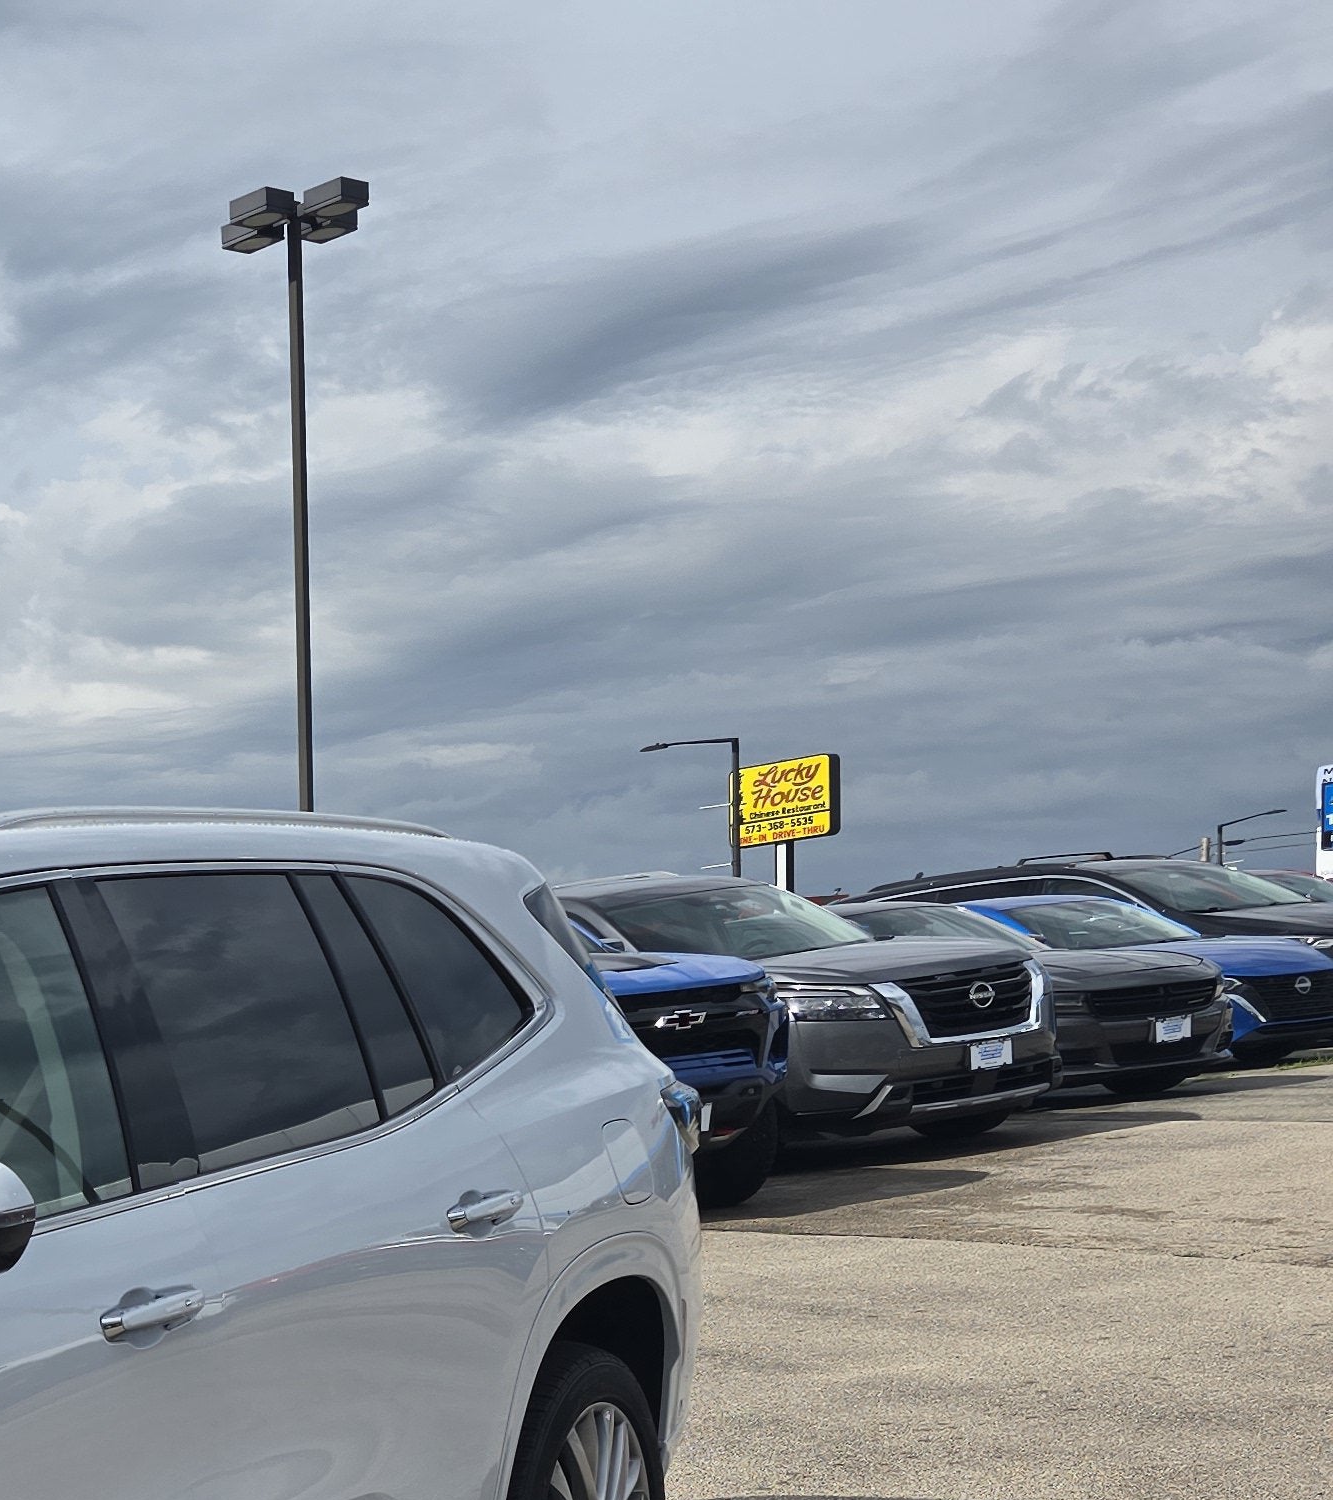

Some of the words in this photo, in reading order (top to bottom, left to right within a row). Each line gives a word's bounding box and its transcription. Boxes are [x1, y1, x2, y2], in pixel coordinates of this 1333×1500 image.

[753, 763, 821, 788] Lucky
[751, 784, 824, 809] House
[749, 809, 780, 820] Chinese
[781, 801, 826, 815] Restaurant
[773, 825, 825, 840] DRIVE-THRU
